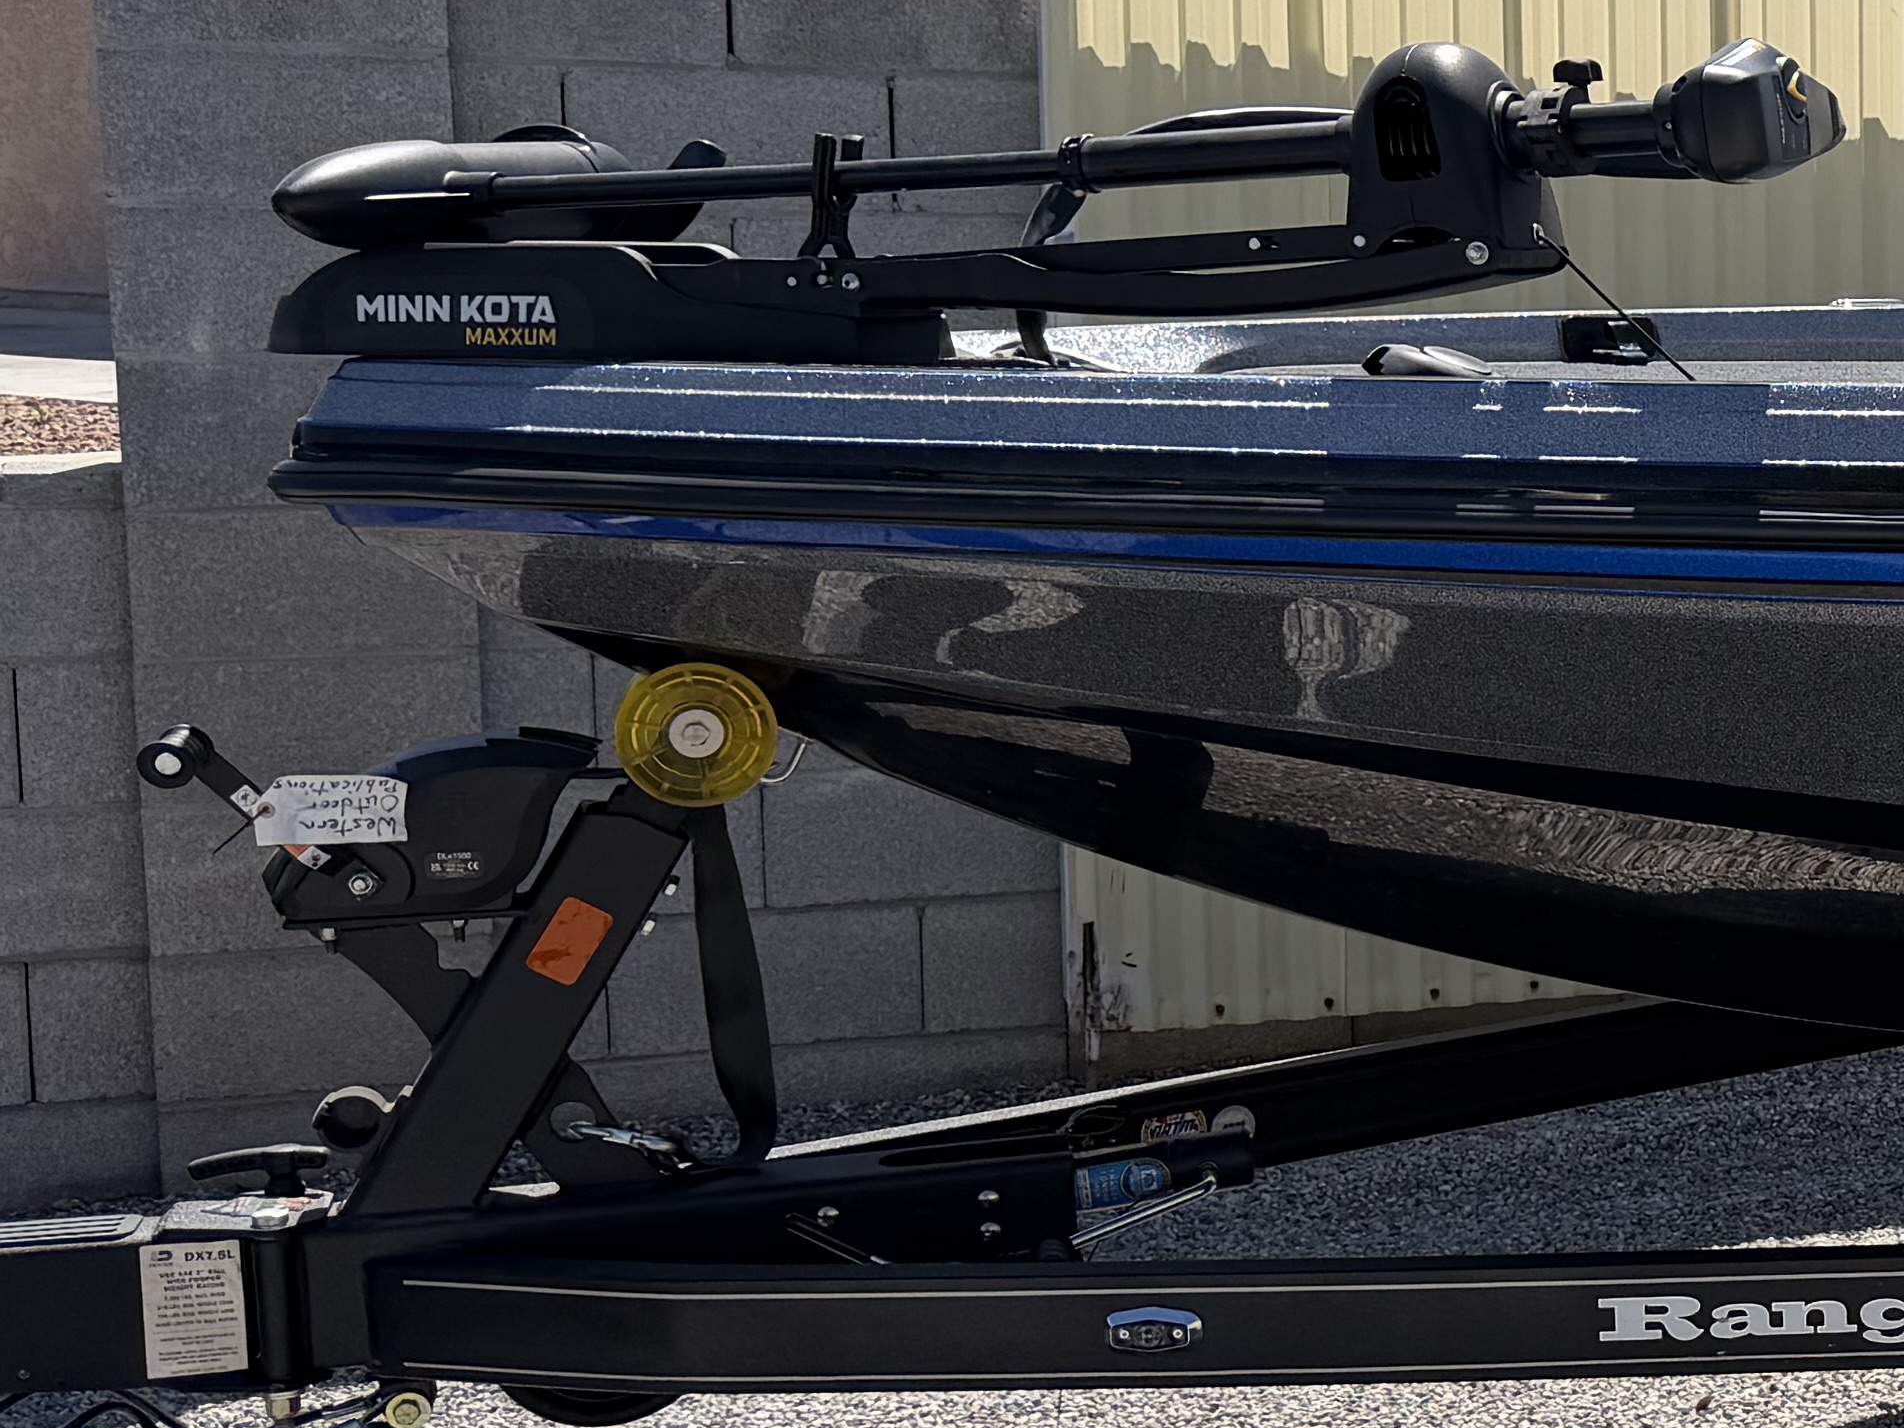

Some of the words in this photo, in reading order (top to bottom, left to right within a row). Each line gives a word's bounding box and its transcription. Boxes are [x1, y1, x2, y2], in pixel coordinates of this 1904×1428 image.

[356, 294, 451, 324] MINN
[460, 294, 556, 324] KOTA
[465, 326, 557, 346] MAXXUM
[273, 778, 398, 796] Publications
[293, 794, 399, 817] Outdoor
[299, 817, 396, 837] Western
